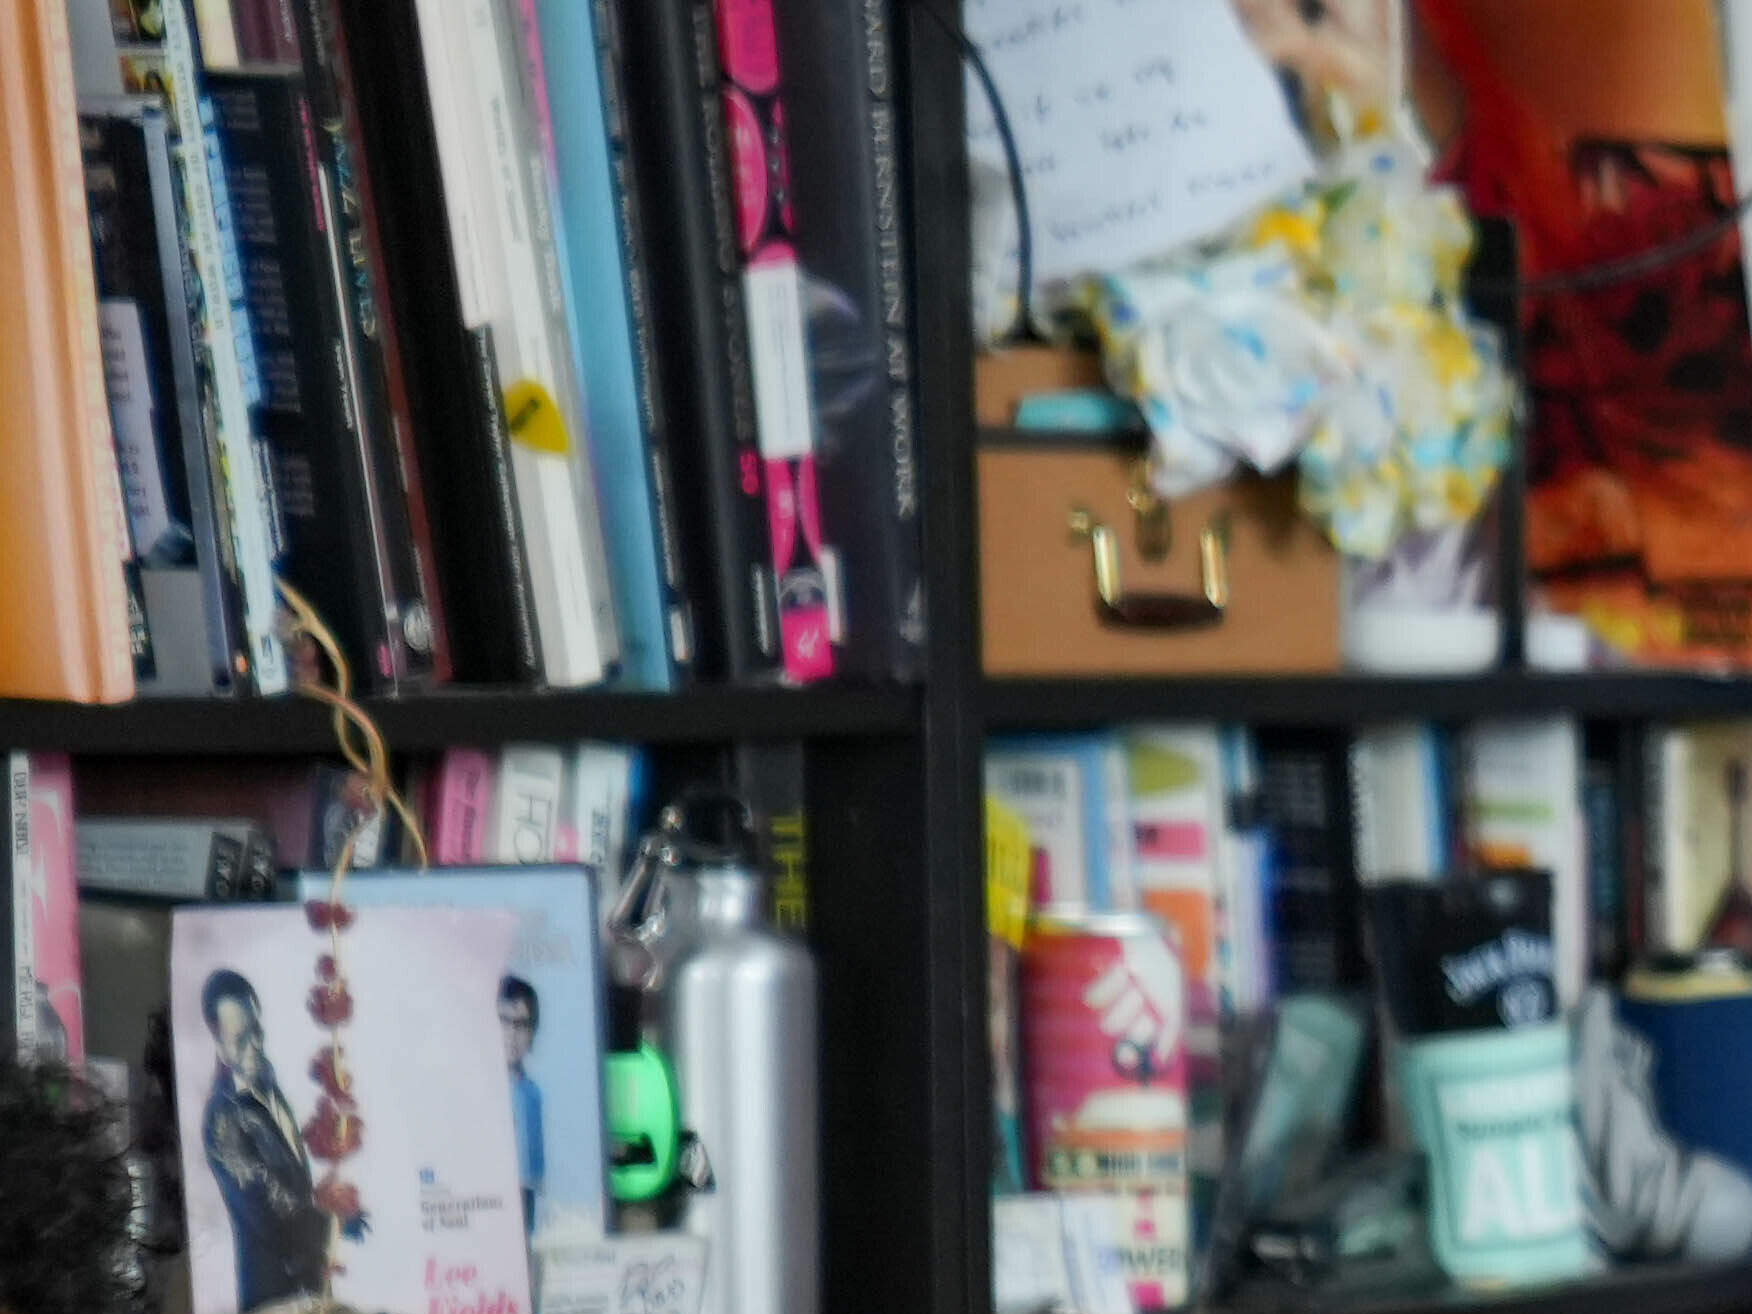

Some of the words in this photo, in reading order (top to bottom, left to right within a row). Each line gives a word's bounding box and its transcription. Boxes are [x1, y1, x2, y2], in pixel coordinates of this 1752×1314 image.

[869, 104, 901, 326] BERNSTEIN
[884, 338, 905, 379] AT
[889, 389, 914, 517] WORK
[424, 1256, 479, 1286] Lee
